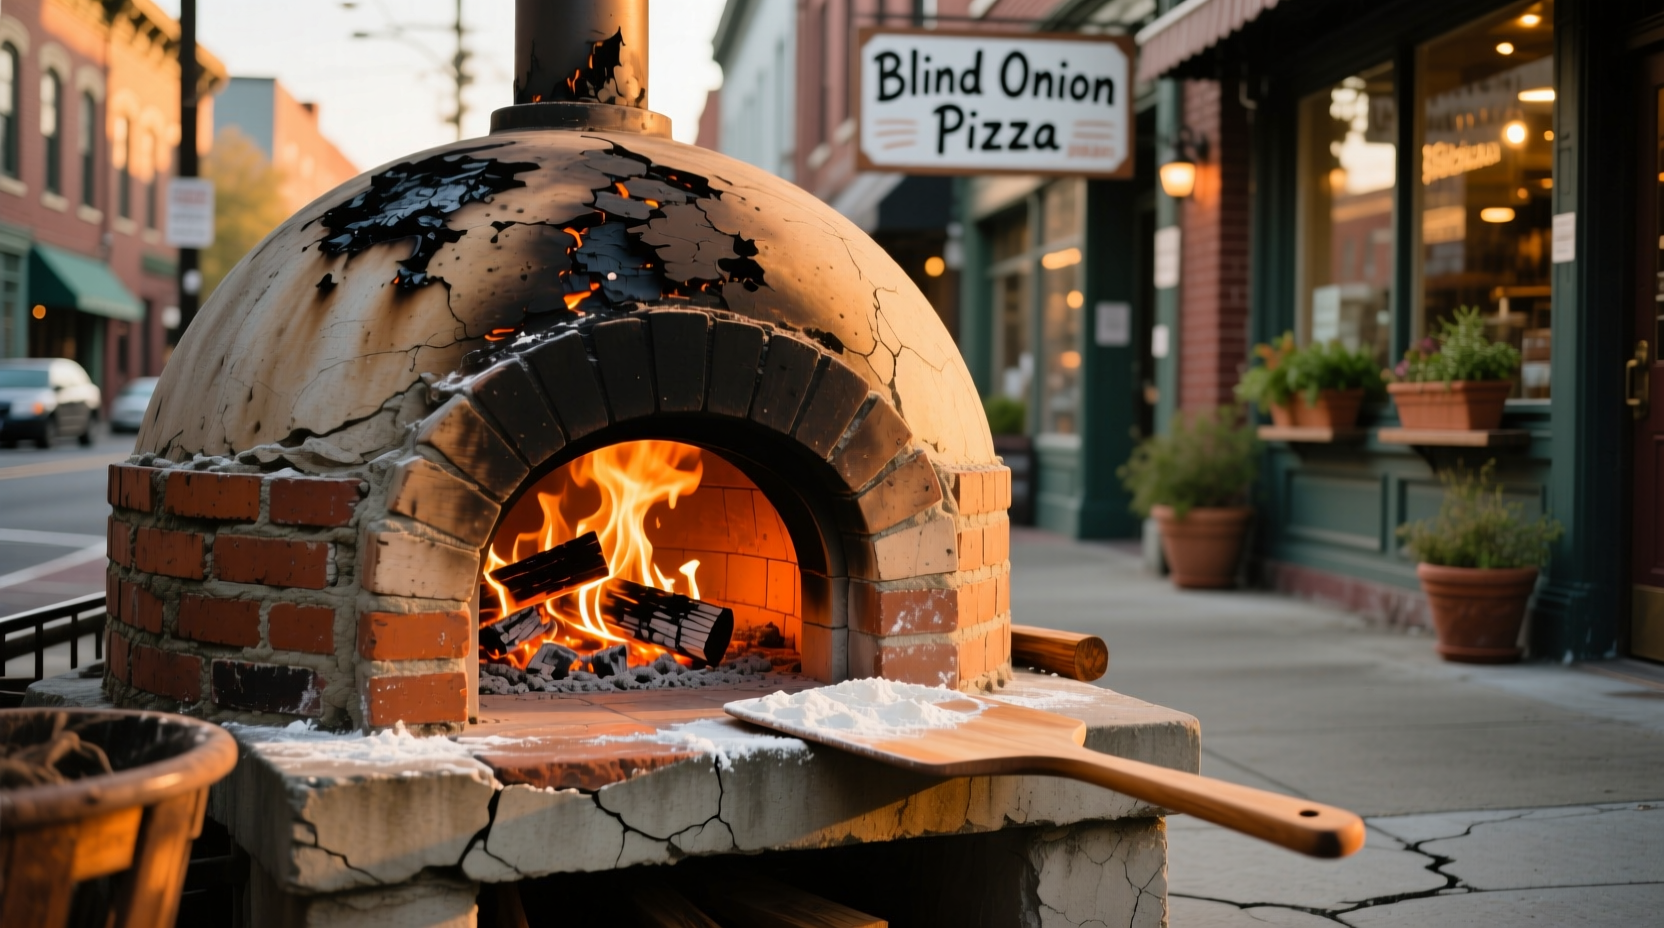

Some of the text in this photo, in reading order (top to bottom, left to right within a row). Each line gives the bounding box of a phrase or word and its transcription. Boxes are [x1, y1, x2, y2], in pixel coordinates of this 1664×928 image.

[874, 49, 1115, 106] Blind Onion
[933, 104, 1060, 155] Pizza
